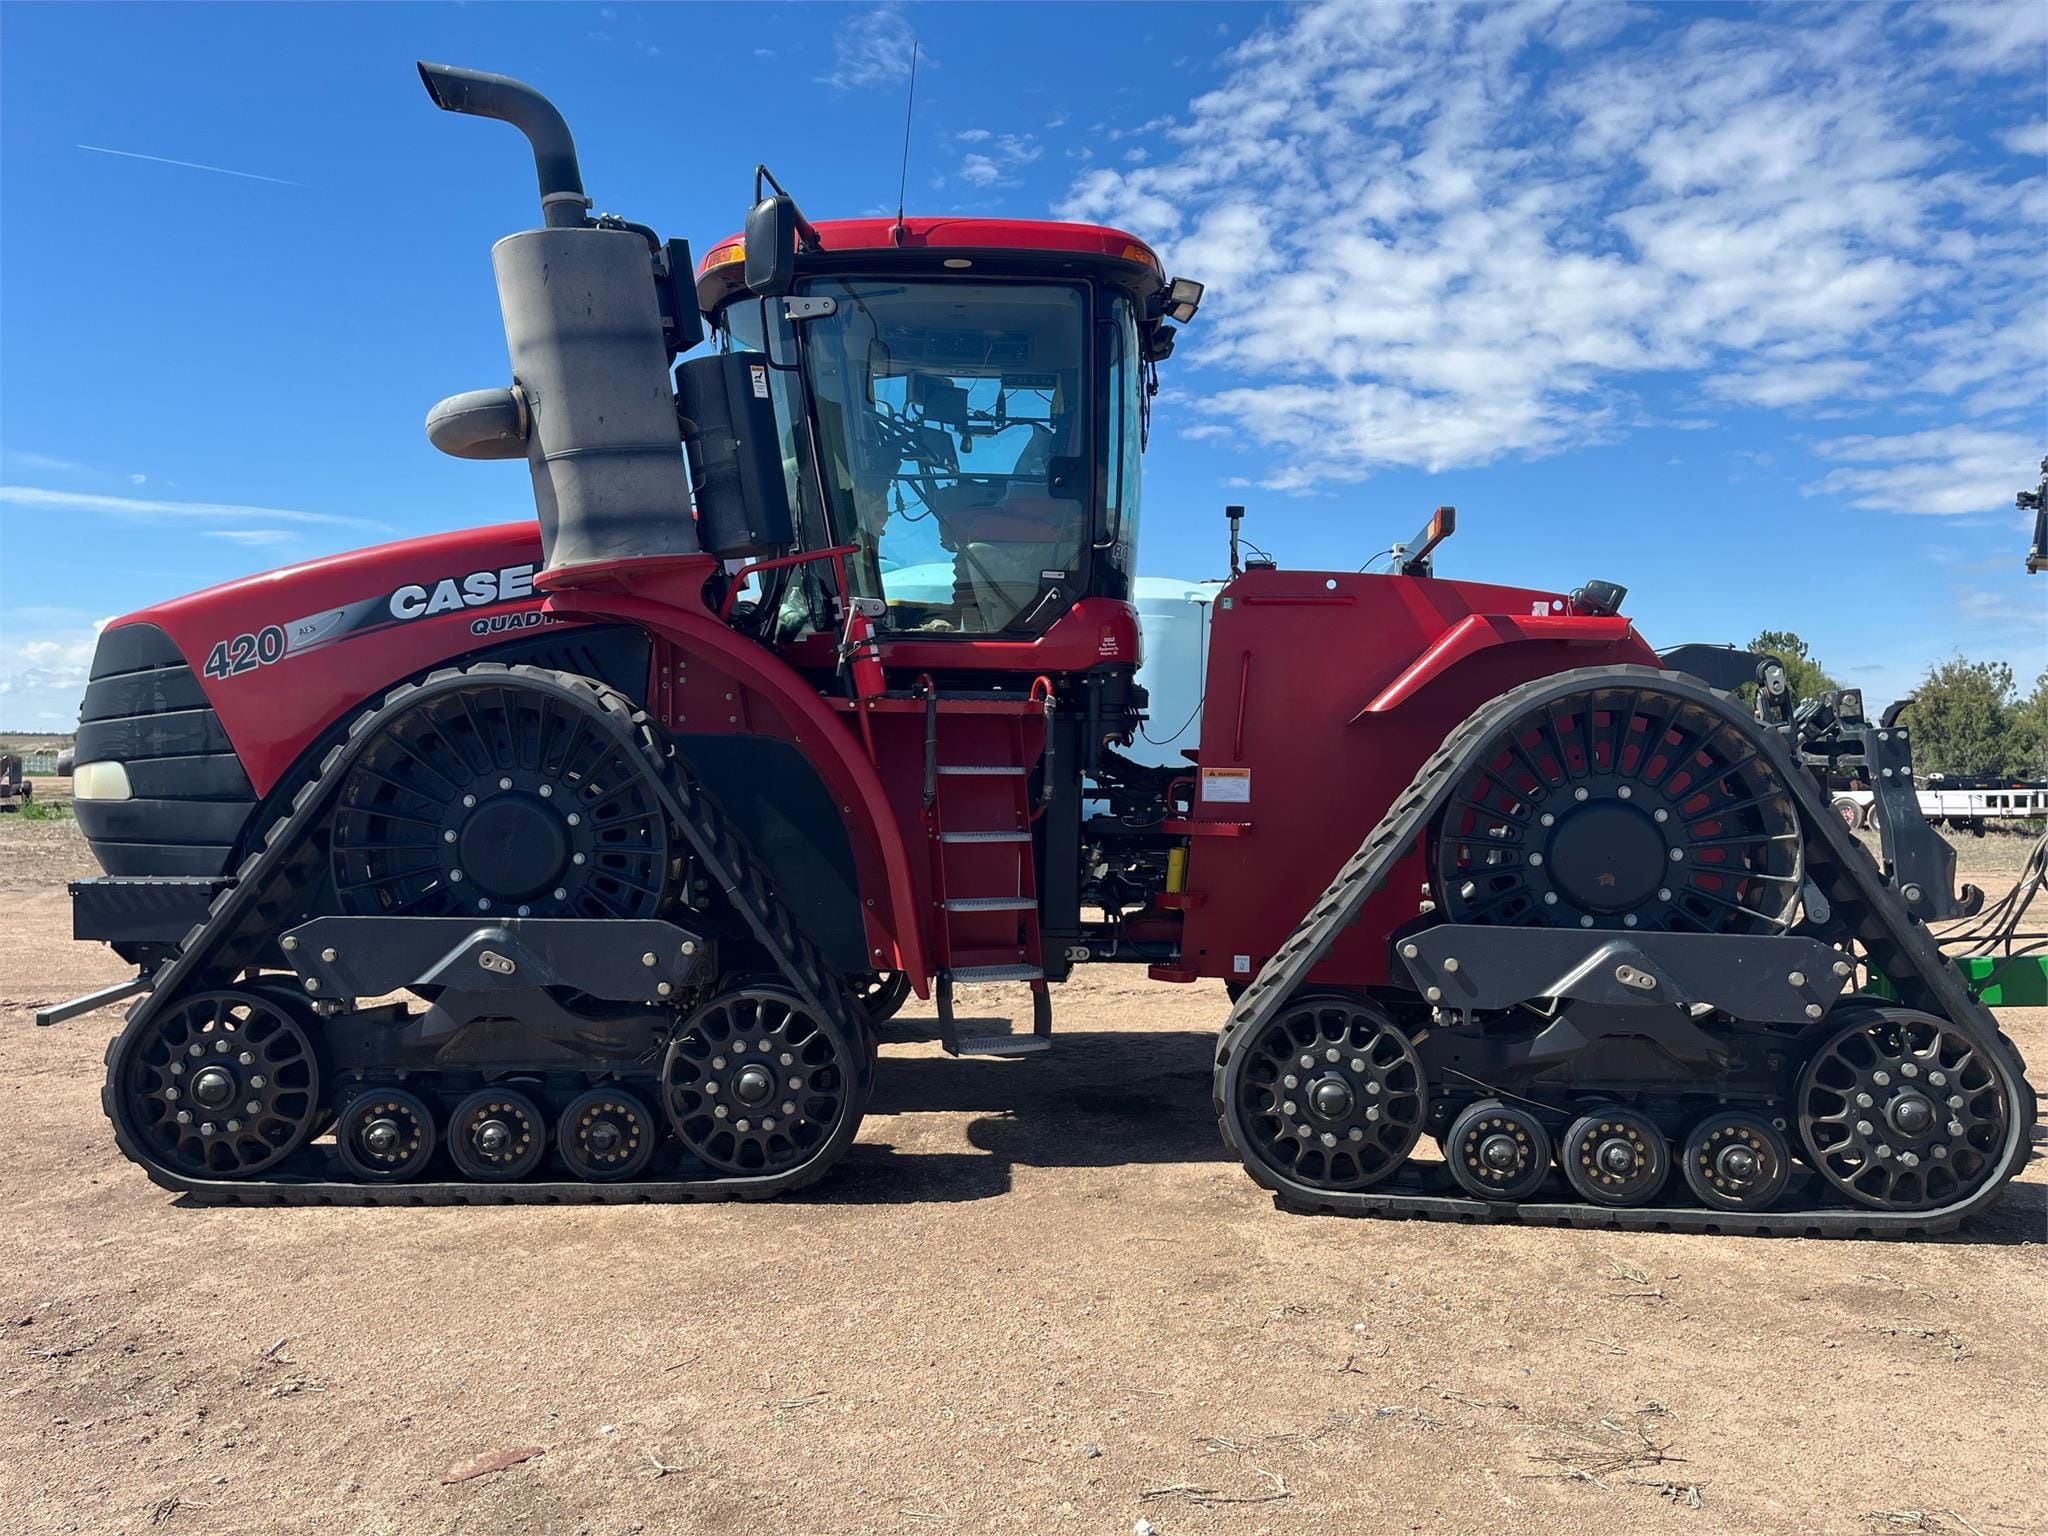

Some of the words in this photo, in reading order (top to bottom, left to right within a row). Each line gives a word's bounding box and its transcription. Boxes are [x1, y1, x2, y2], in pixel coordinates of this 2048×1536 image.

[390, 564, 534, 619] CASE
[470, 611, 566, 636] QUAD
[203, 624, 285, 680] 420
